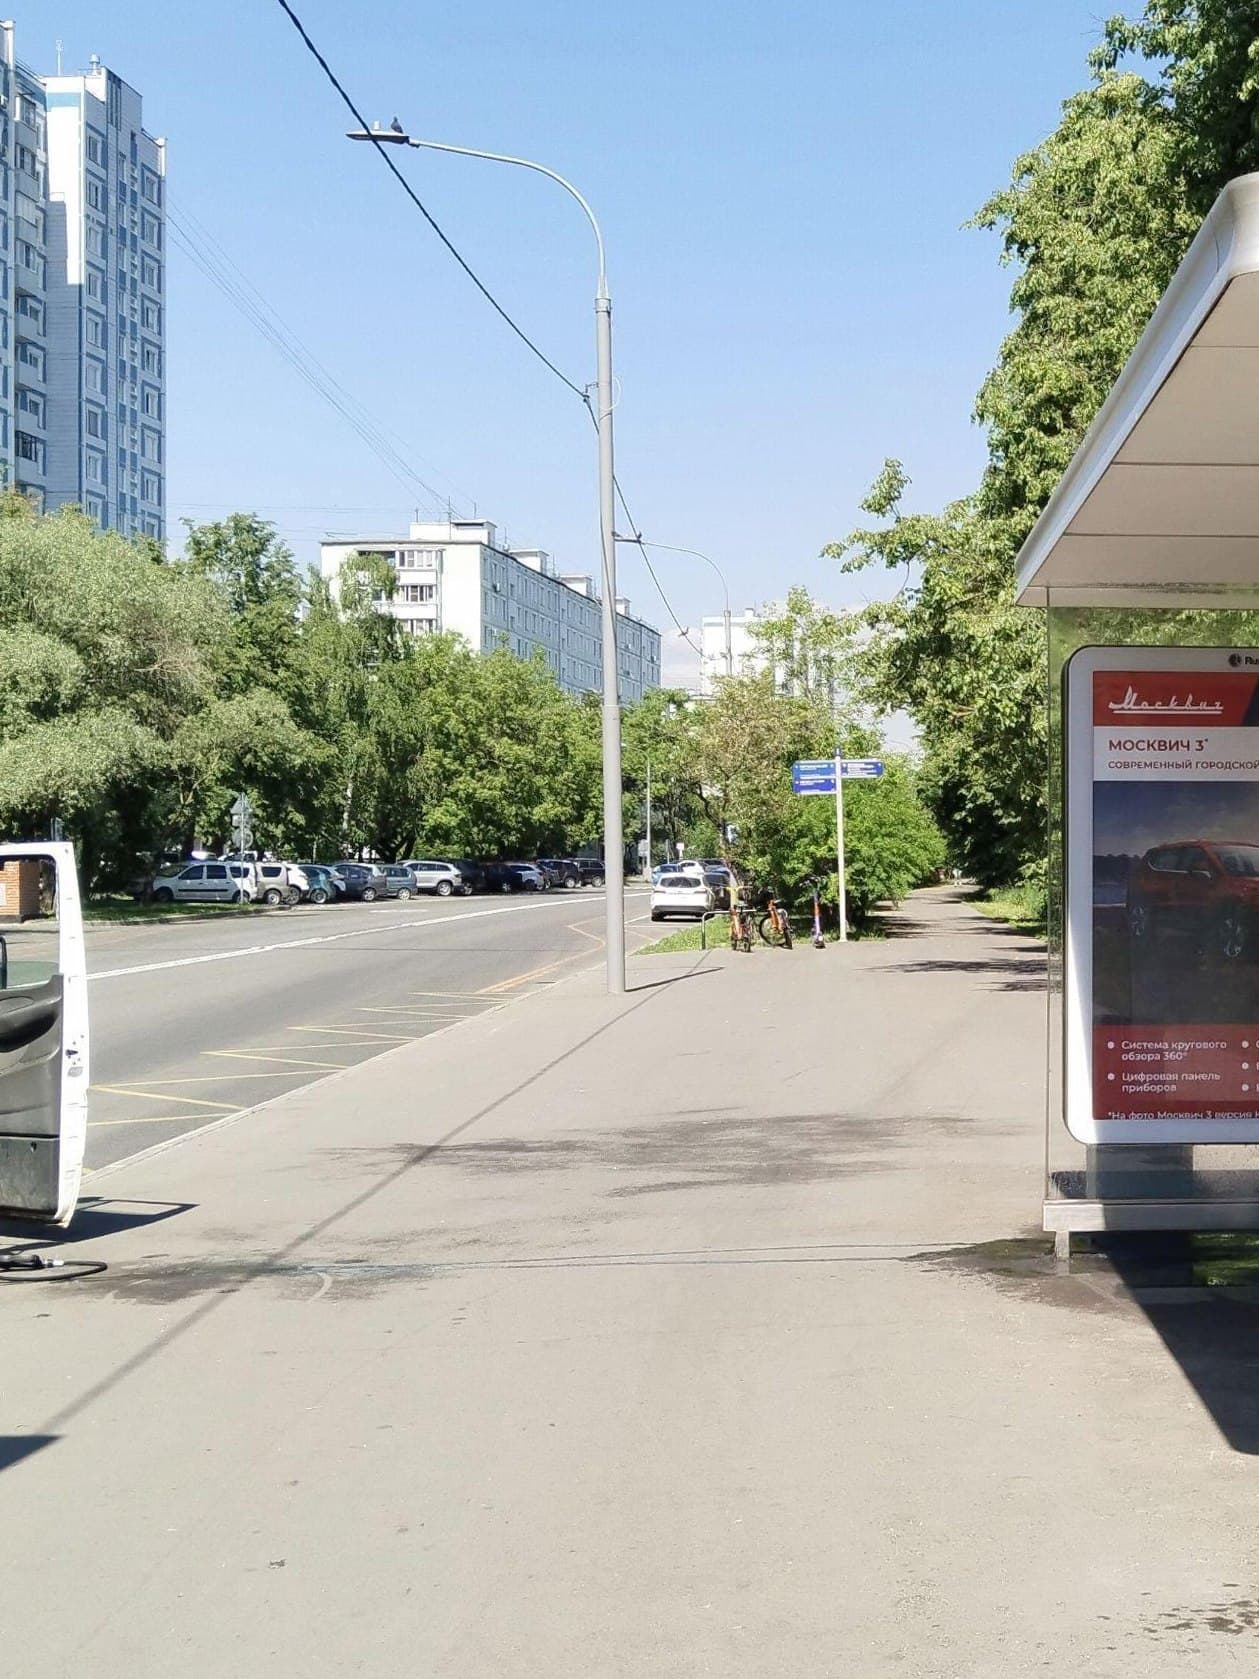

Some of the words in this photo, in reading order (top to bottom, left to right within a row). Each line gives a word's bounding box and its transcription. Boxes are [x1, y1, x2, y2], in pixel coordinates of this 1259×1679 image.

[1108, 739, 1191, 752] МОСКВИЧ
[1108, 759, 1193, 770] СОВРЕМЕННЫЙ
[1121, 1040, 1169, 1050] Система
[1171, 1041, 1227, 1052] кругового
[1121, 1051, 1161, 1062] обзора
[1121, 1072, 1179, 1083] Цифровая
[1181, 1072, 1221, 1081] панель
[1121, 1083, 1177, 1093] приборов
